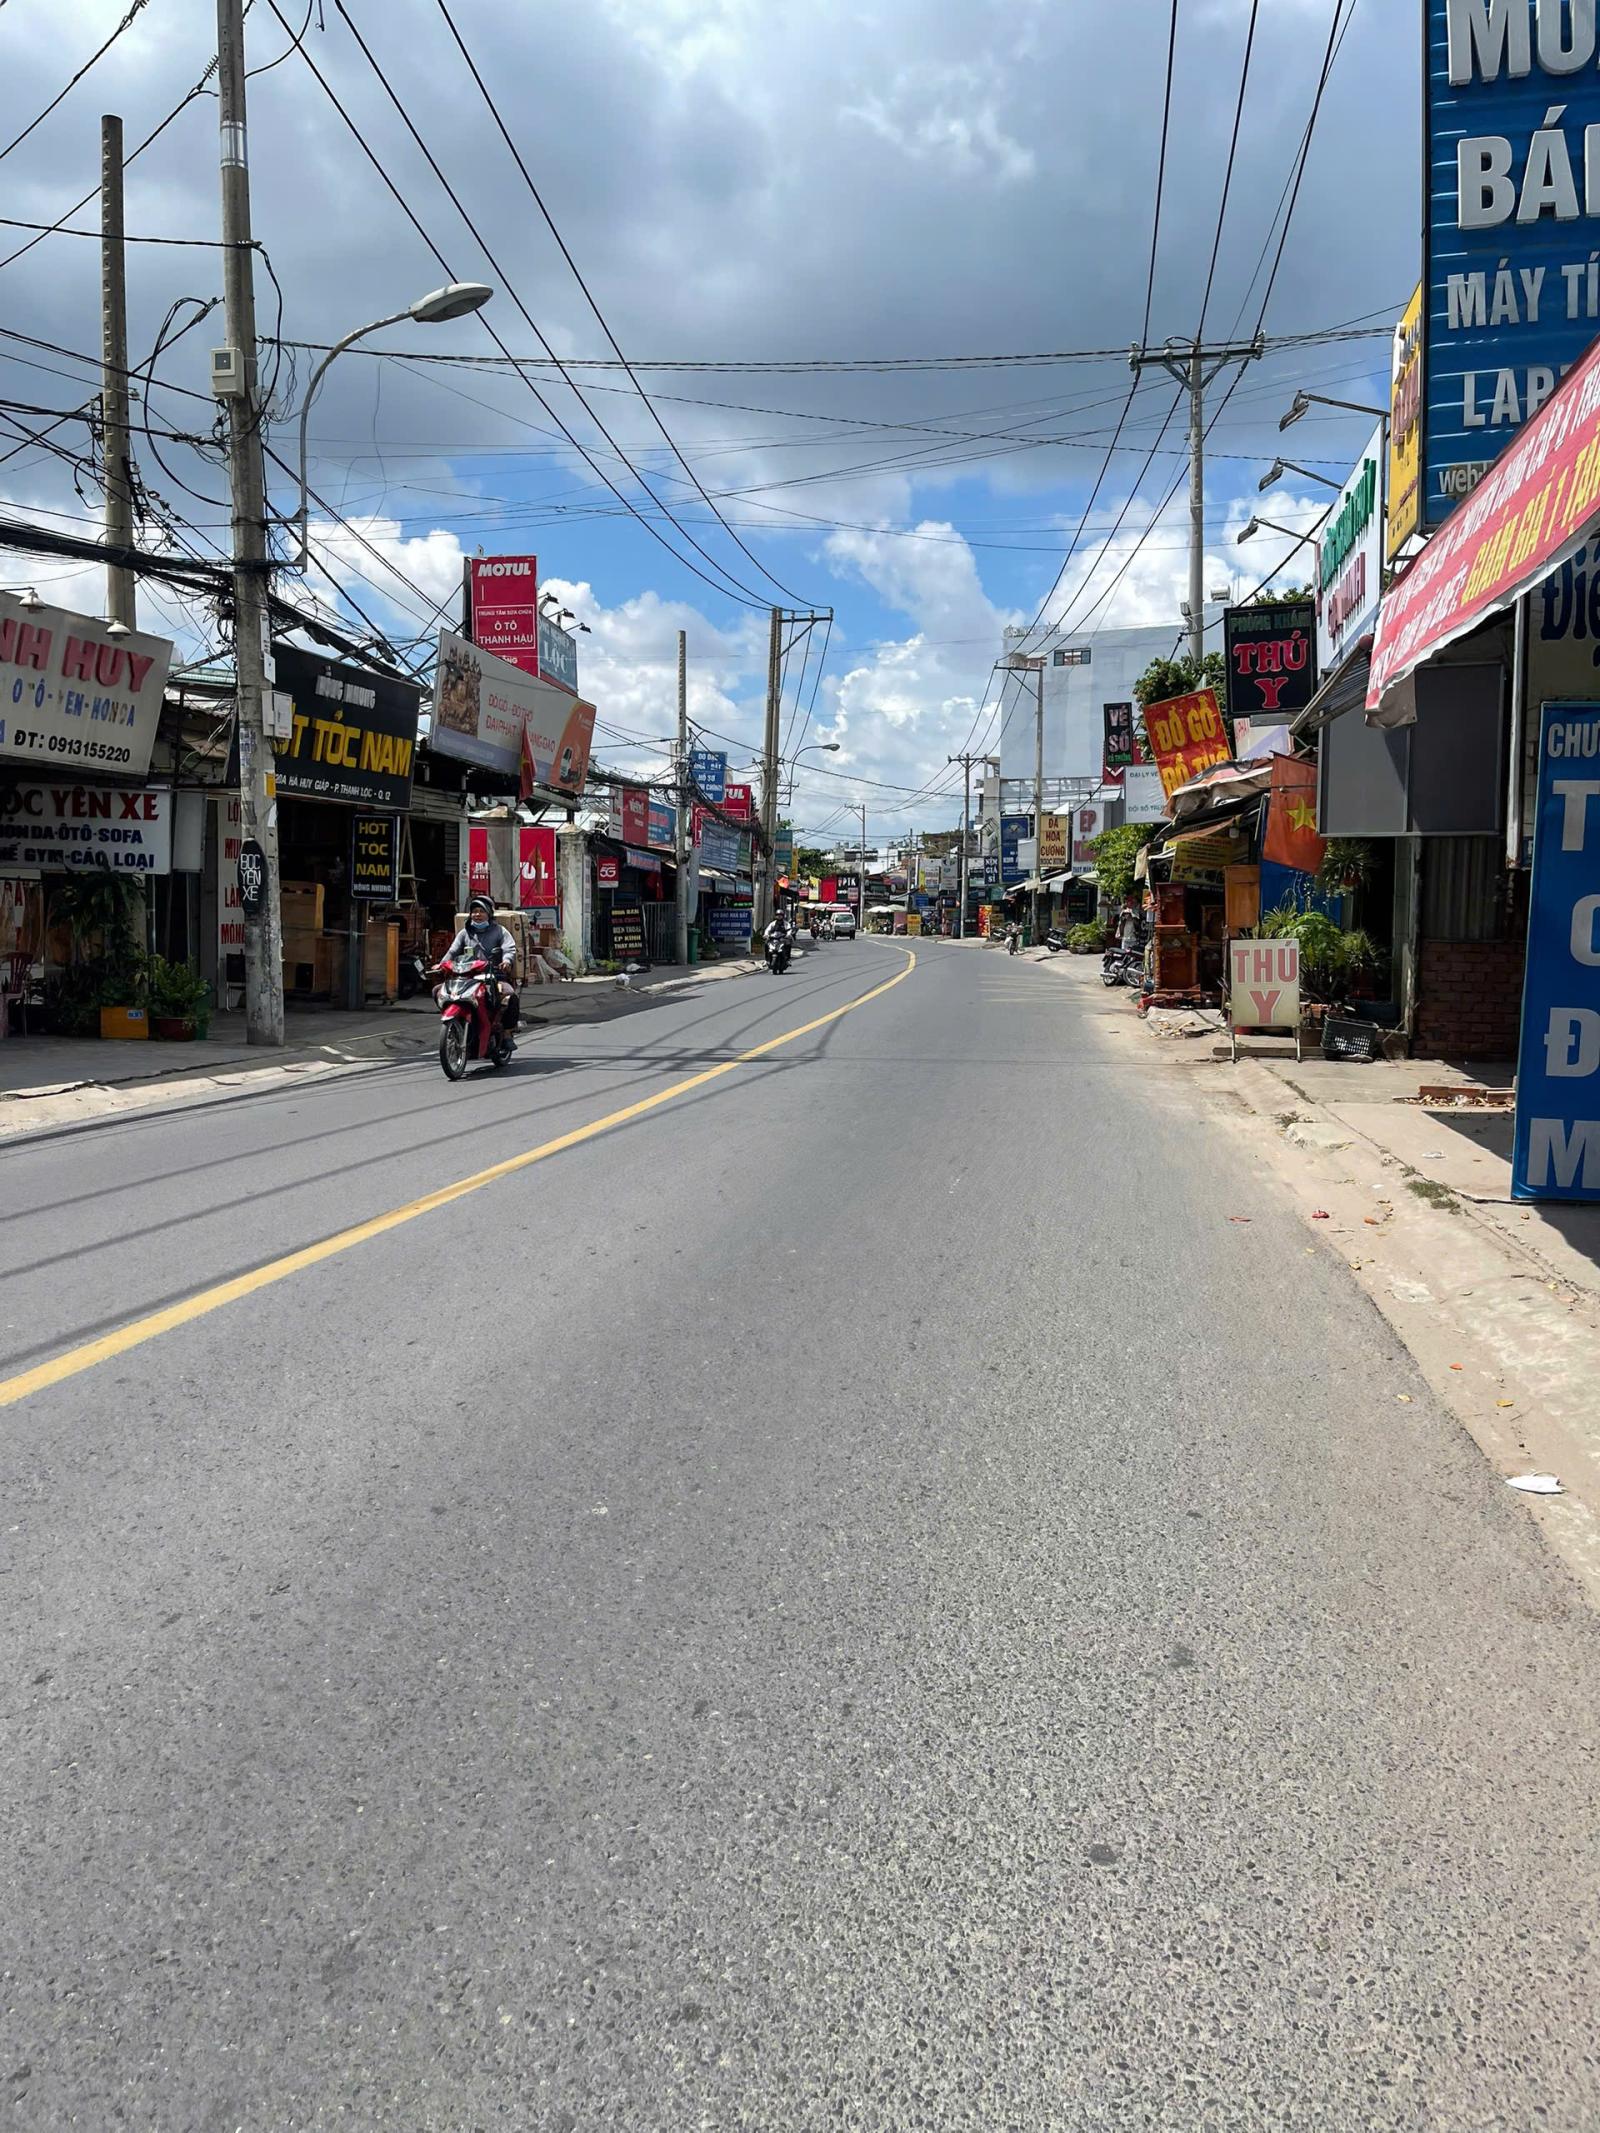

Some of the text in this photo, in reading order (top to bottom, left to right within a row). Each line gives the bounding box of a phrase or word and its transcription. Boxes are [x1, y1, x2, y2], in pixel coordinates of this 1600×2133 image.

[1447, 258, 1546, 330] MÁY
[478, 563, 531, 577] MOTUL
[494, 620, 517, 631] Ô TÔ
[479, 635, 511, 645] THANH
[1233, 629, 1308, 674] THÚ
[62, 635, 155, 693] HUY
[1254, 676, 1289, 709] Y
[1108, 705, 1128, 727] VÉ
[14, 729, 45, 748] ĐT:
[48, 735, 131, 763] 0913155220
[360, 730, 413, 777] NAM
[1108, 729, 1130, 753] SỐ
[51, 786, 112, 818] YÊN
[119, 793, 160, 821] XE
[114, 852, 155, 871] LOẠI
[356, 863, 390, 877] NAM
[600, 866, 616, 877] 5G
[243, 886, 258, 901] XE
[1233, 940, 1297, 983] THÚ
[1249, 990, 1281, 1024] Y
